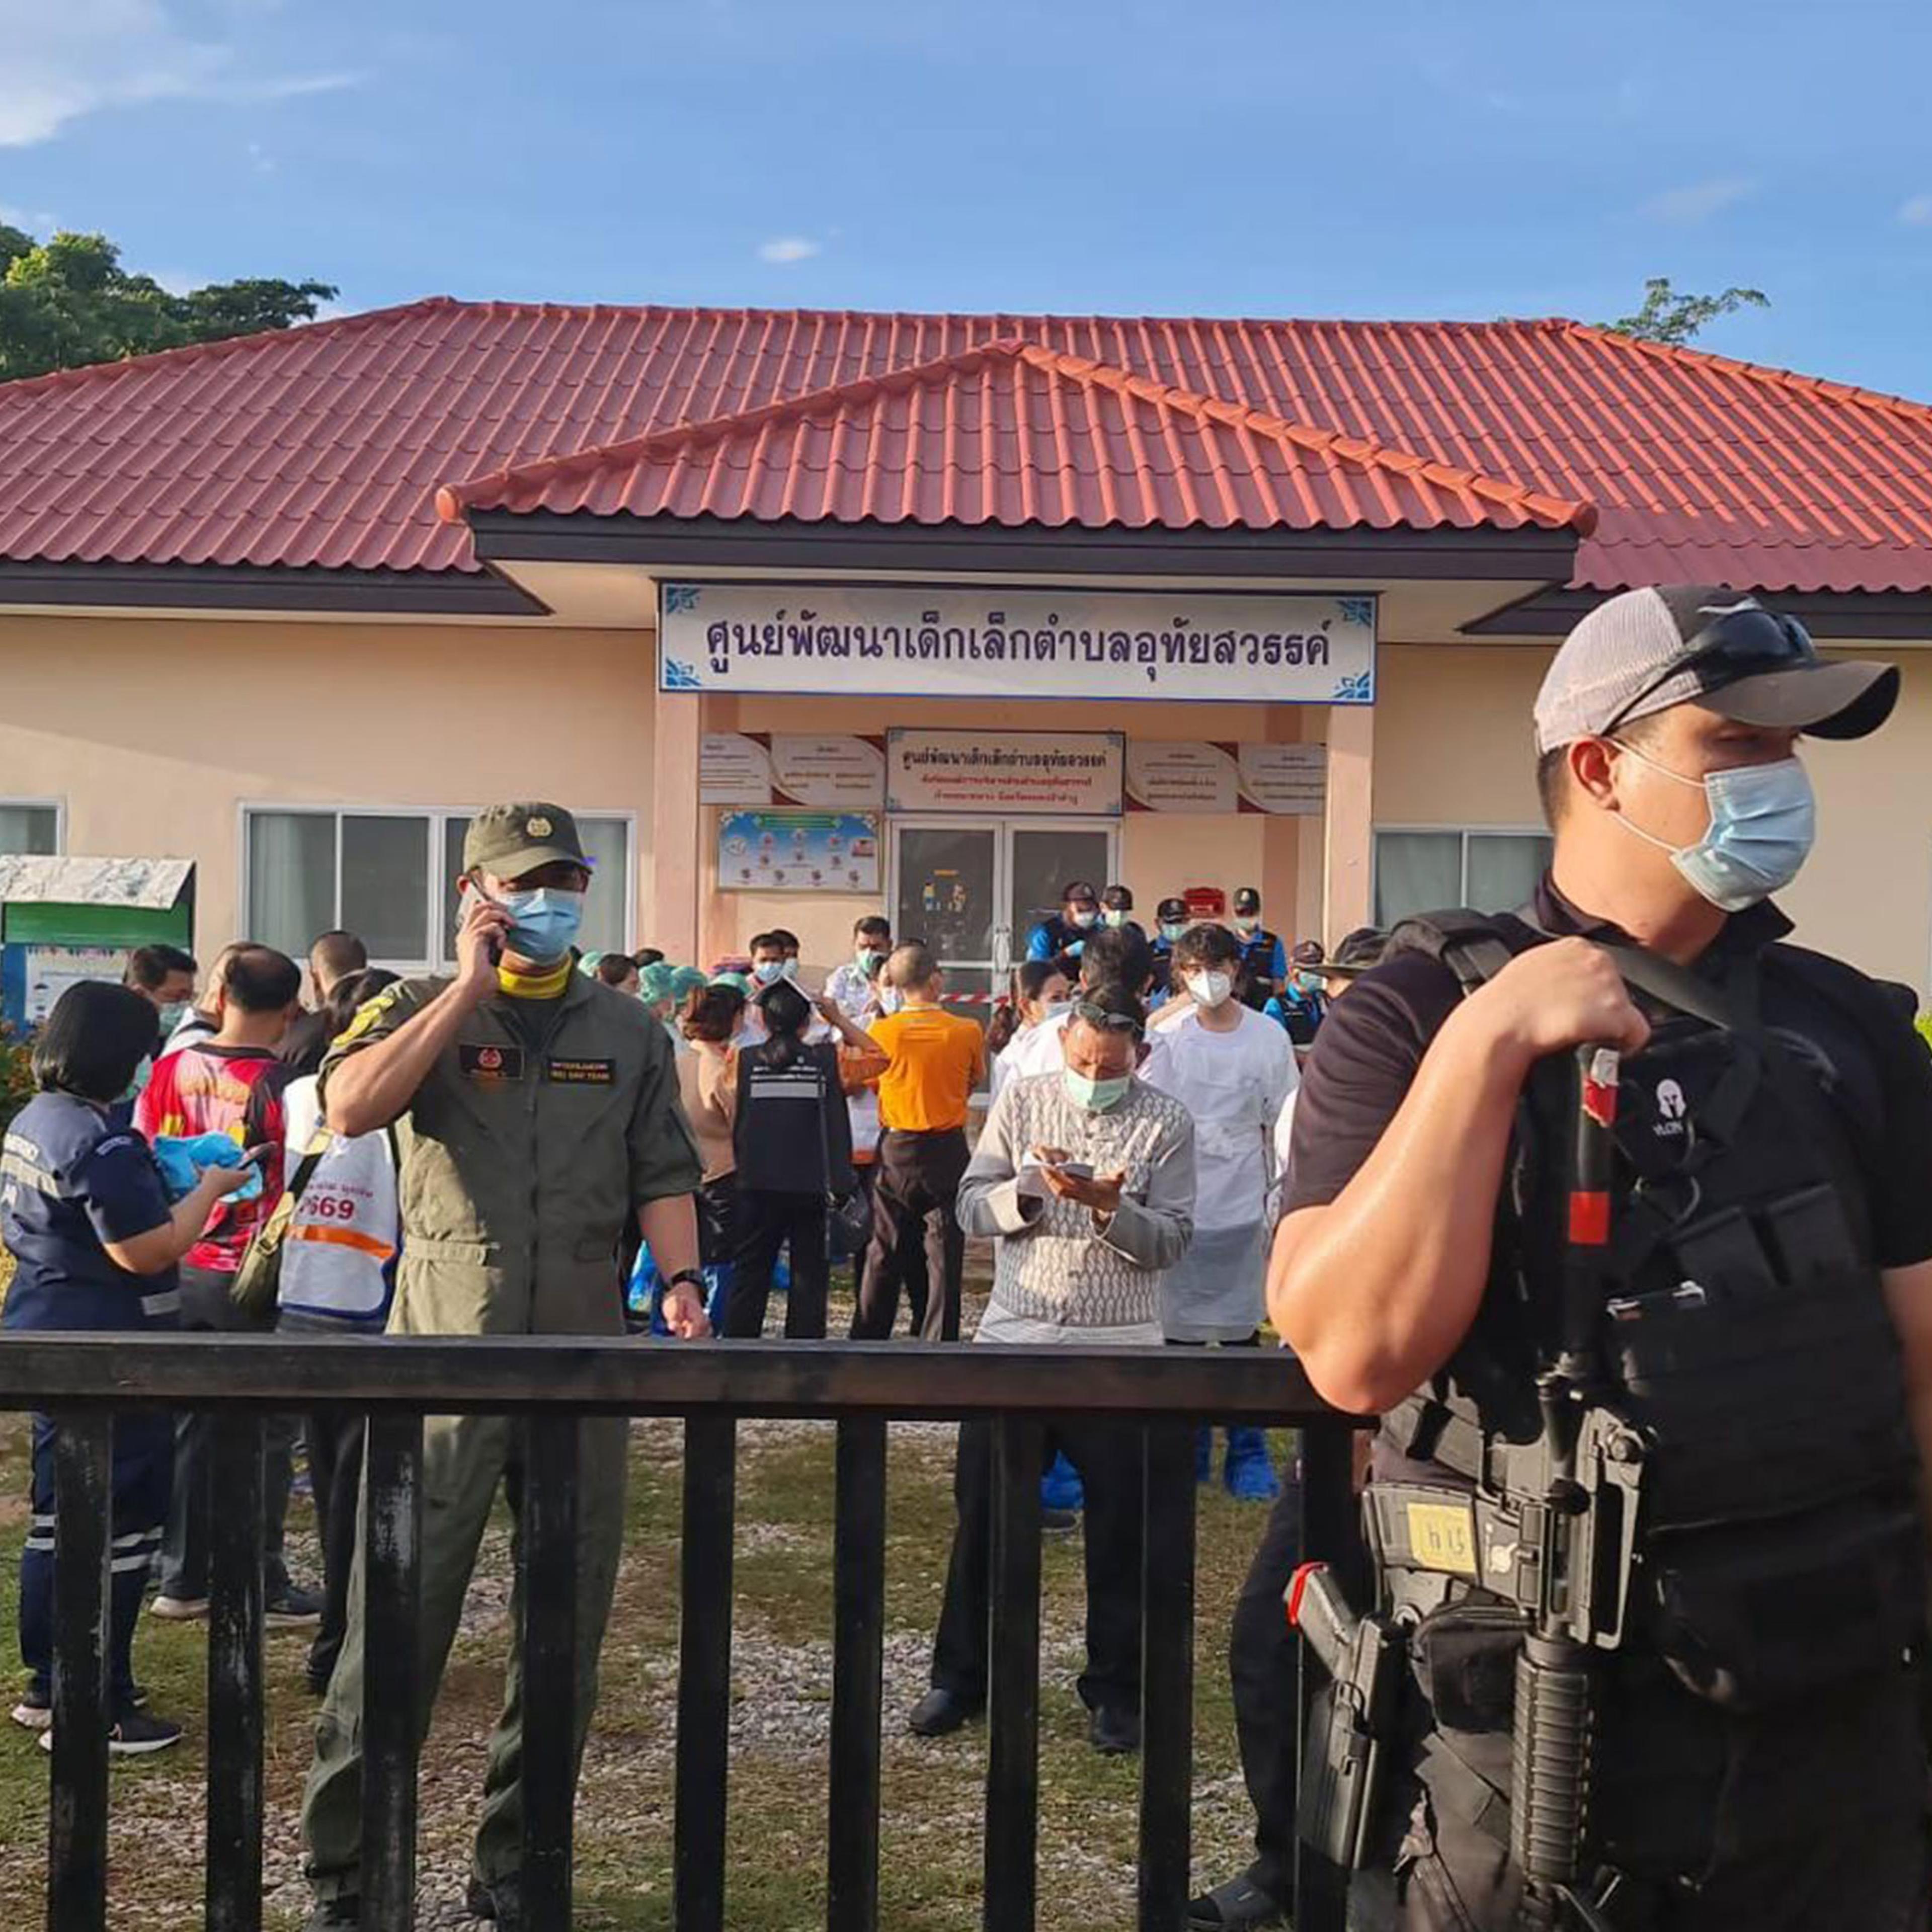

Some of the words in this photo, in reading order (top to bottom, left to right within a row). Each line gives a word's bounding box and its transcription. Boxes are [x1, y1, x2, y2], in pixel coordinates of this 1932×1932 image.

[707, 609, 1331, 681] ศูนย์พัฒนาเด็กเล็กตำบลอุทัยสวรรค์
